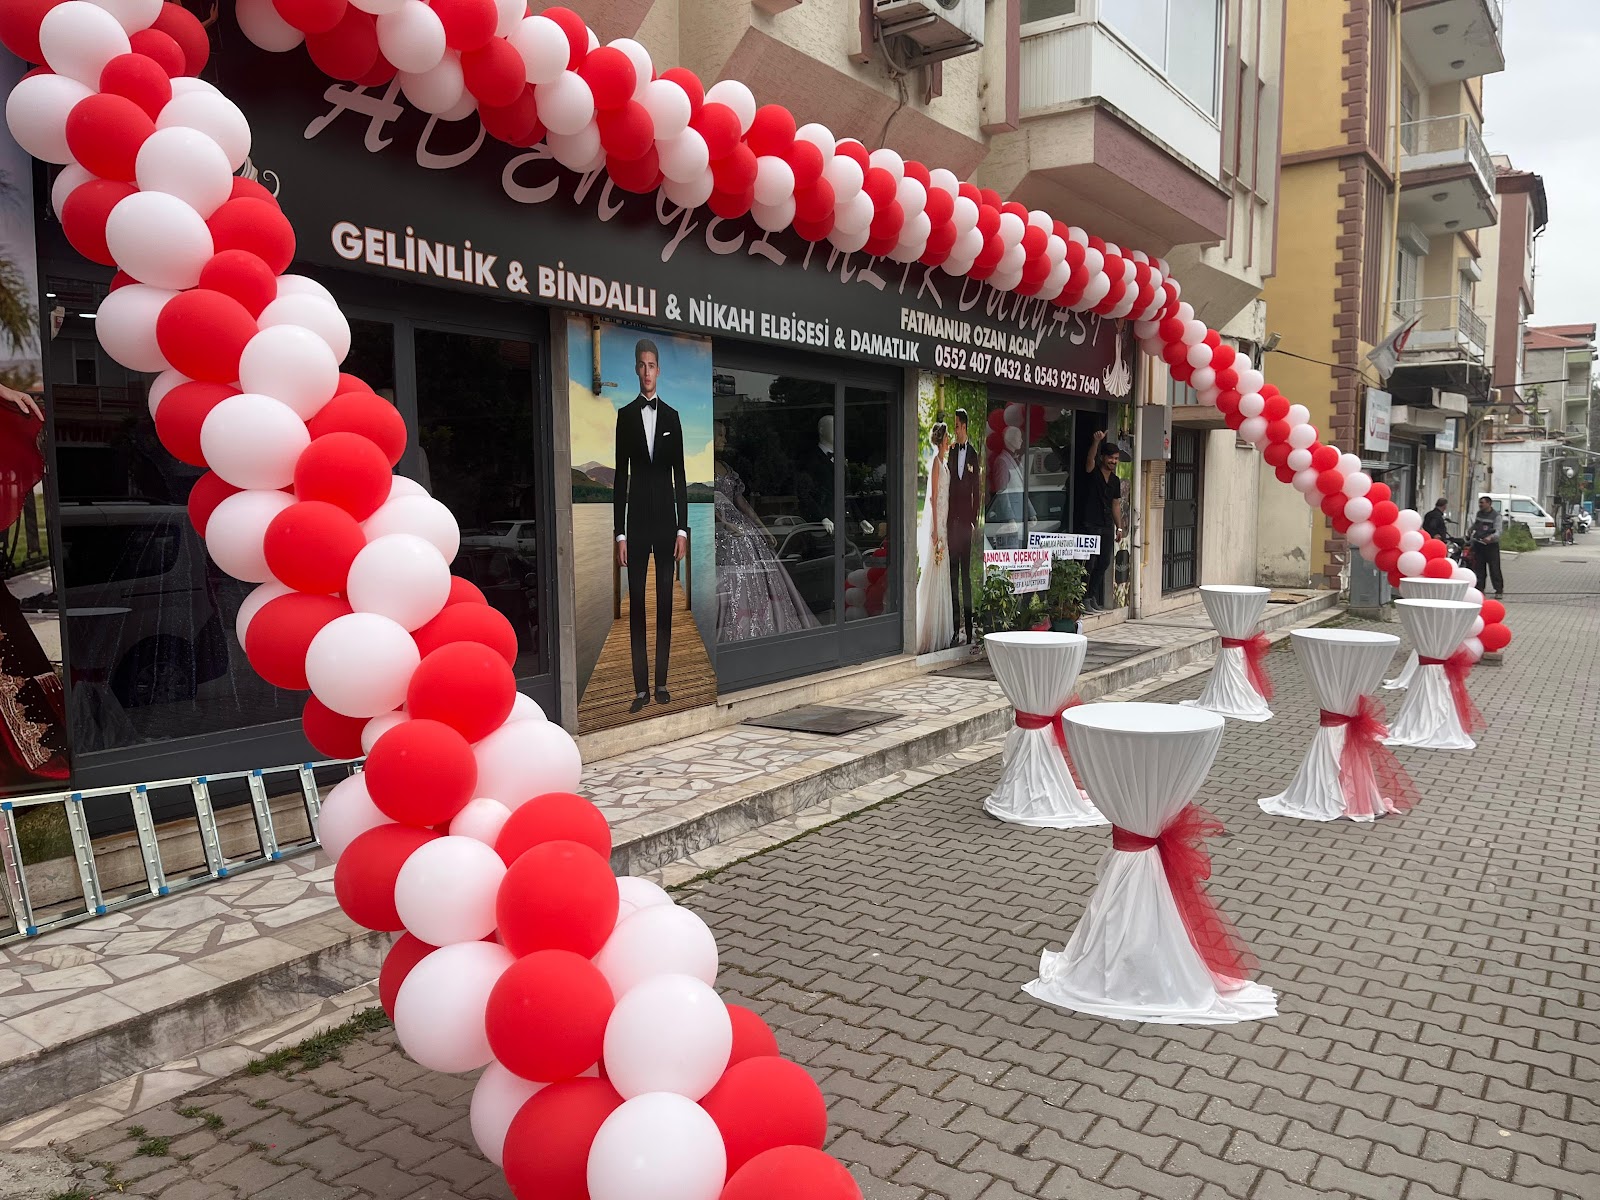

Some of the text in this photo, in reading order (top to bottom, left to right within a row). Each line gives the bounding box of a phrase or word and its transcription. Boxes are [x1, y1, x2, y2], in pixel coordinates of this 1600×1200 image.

[331, 221, 920, 363] GELİNLİK & BİNDALLI & NİKAH ELBİSESİ & DAMATLIK
[900, 308, 1036, 360] FATMANUR OZAN ACAR
[934, 344, 1100, 395] 0552 407 0432 & 0543 925 7640
[1074, 536, 1098, 549] İLESİ
